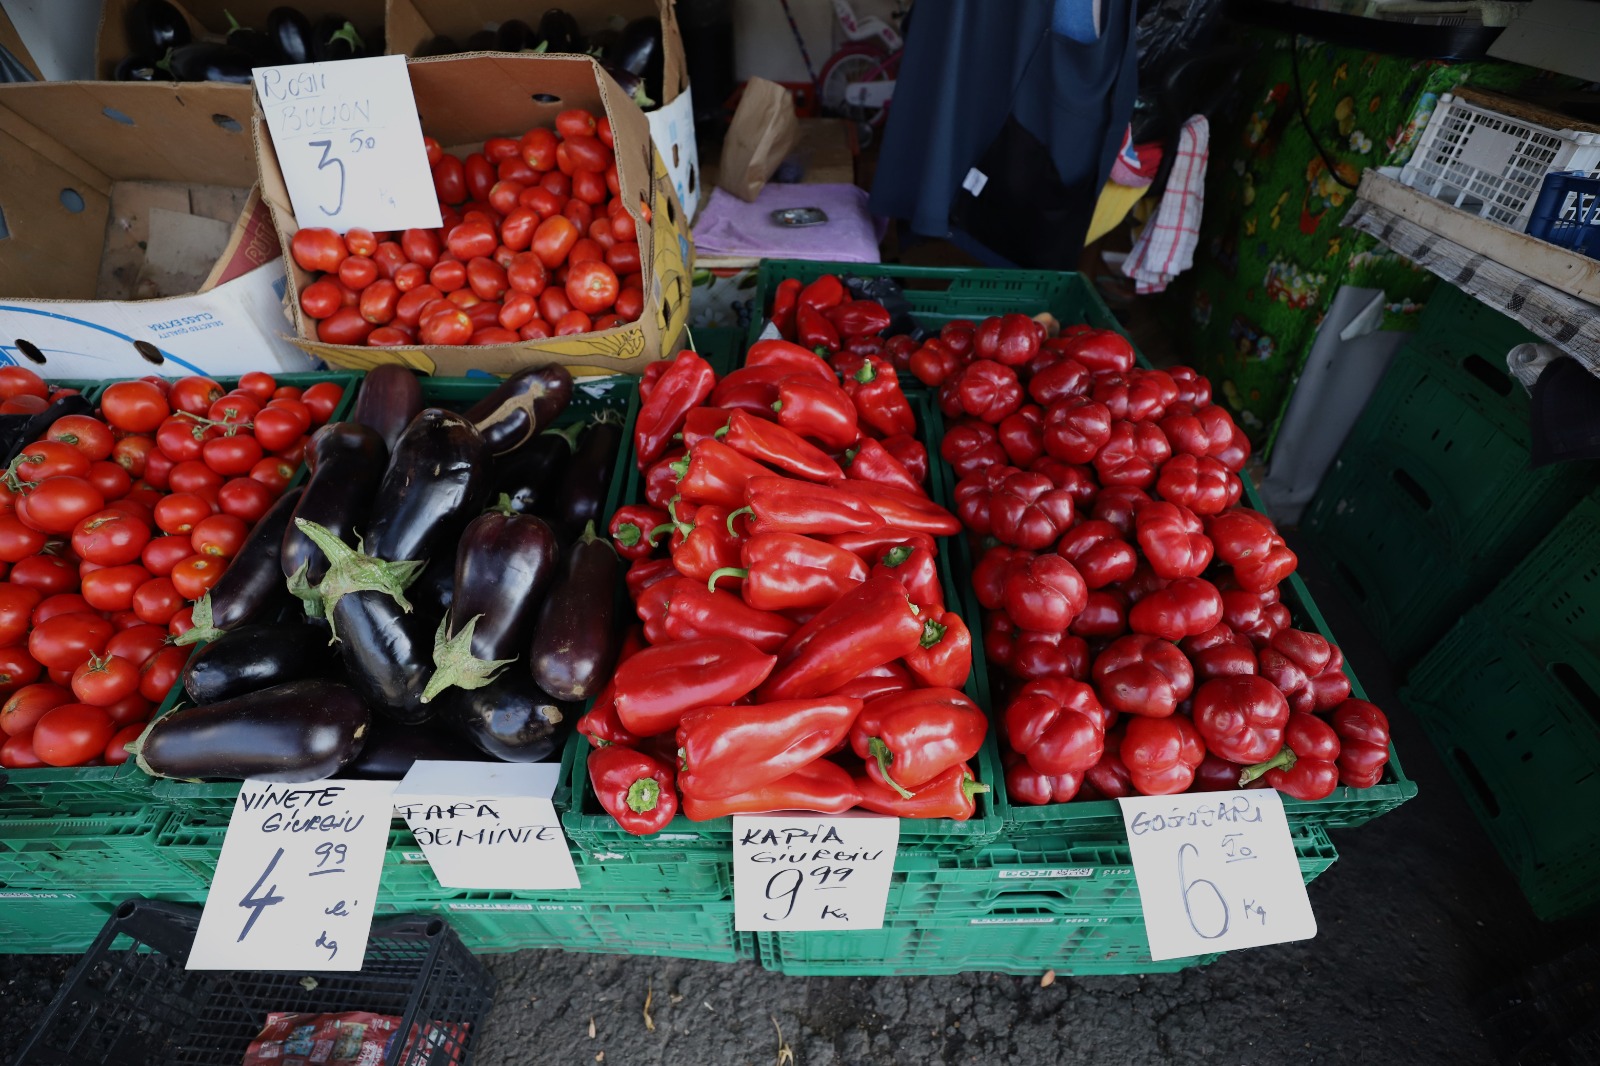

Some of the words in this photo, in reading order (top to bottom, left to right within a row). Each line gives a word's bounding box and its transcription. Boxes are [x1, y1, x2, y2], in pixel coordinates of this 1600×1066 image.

[308, 139, 346, 216] 3
[350, 129, 376, 153] 50
[147, 319, 183, 332] EXTRA
[158, 328, 189, 339] QUALITY
[181, 312, 213, 325] CLASS
[188, 320, 224, 332] SELECTED
[236, 847, 285, 943] 4
[314, 841, 348, 868] 99
[763, 868, 804, 921] 9
[810, 865, 854, 885] 99
[1177, 842, 1230, 939] 6
